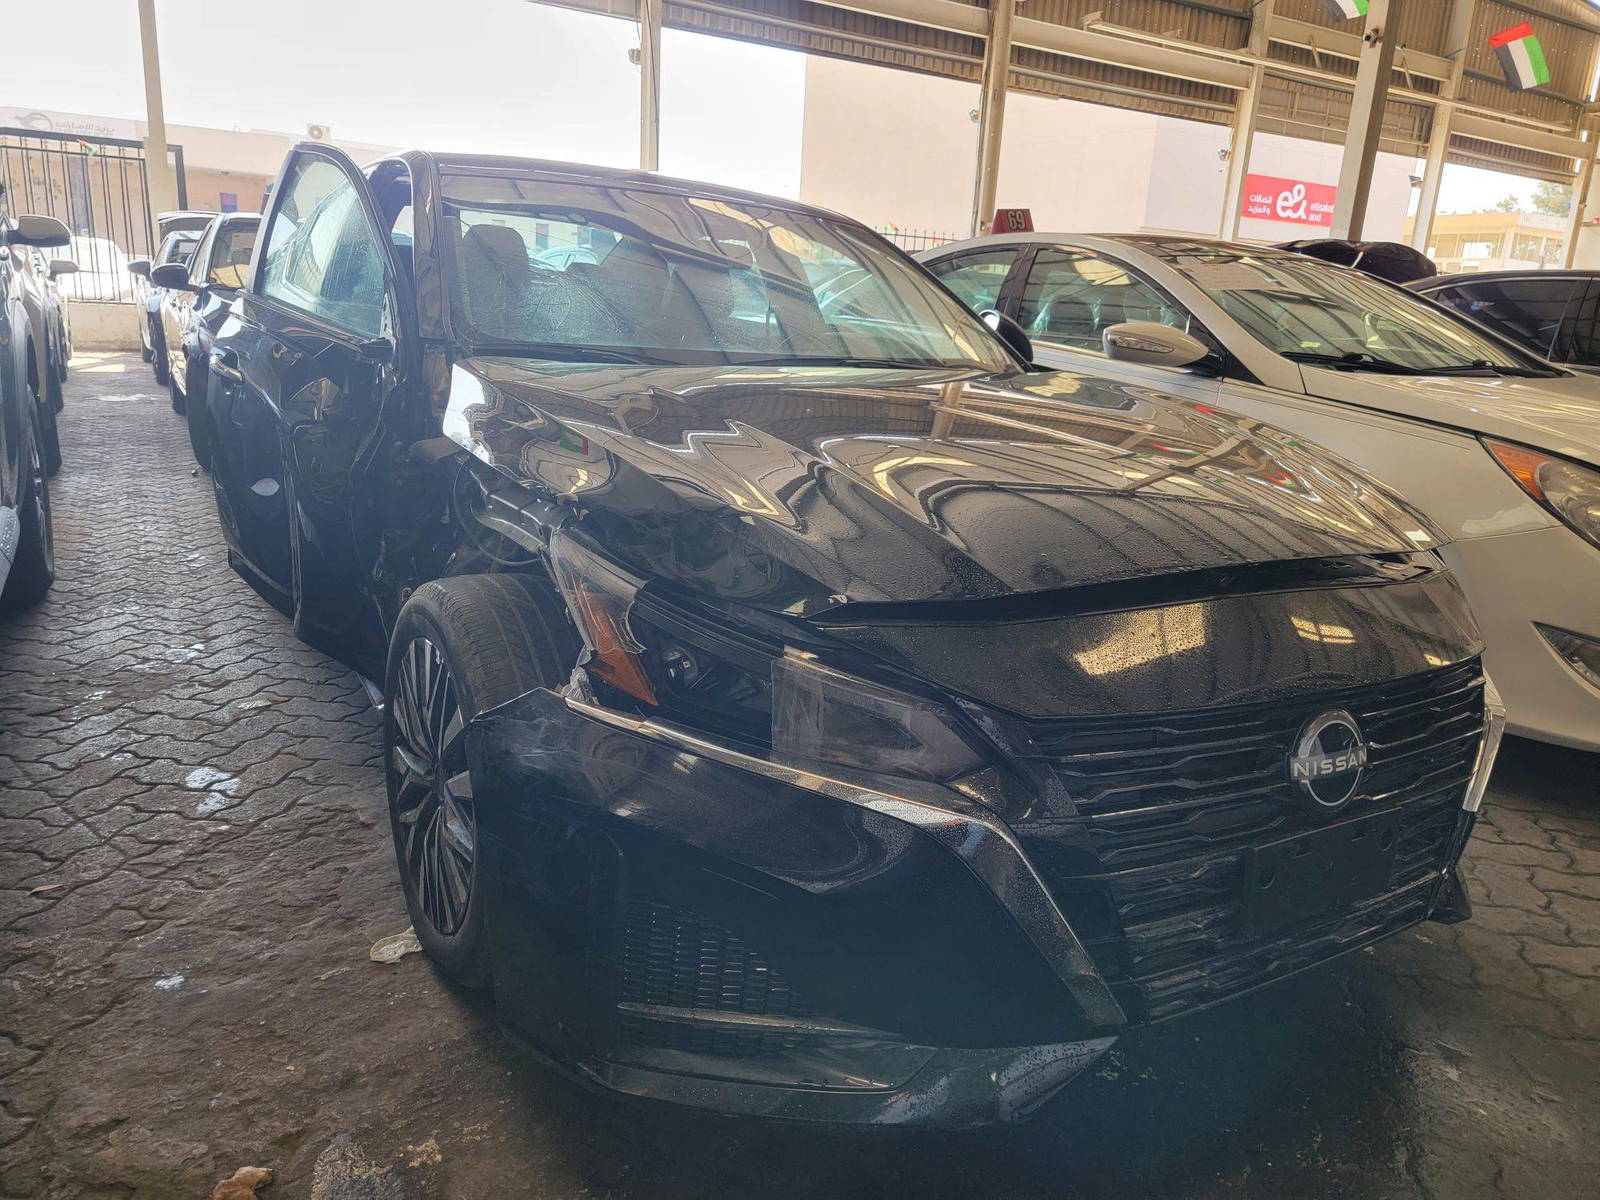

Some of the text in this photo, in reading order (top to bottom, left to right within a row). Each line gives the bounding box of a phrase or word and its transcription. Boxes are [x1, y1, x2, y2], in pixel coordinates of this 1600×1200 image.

[1007, 210, 1026, 230] 69
[1308, 213, 1322, 222] and
[1293, 747, 1367, 777] NISSAN
